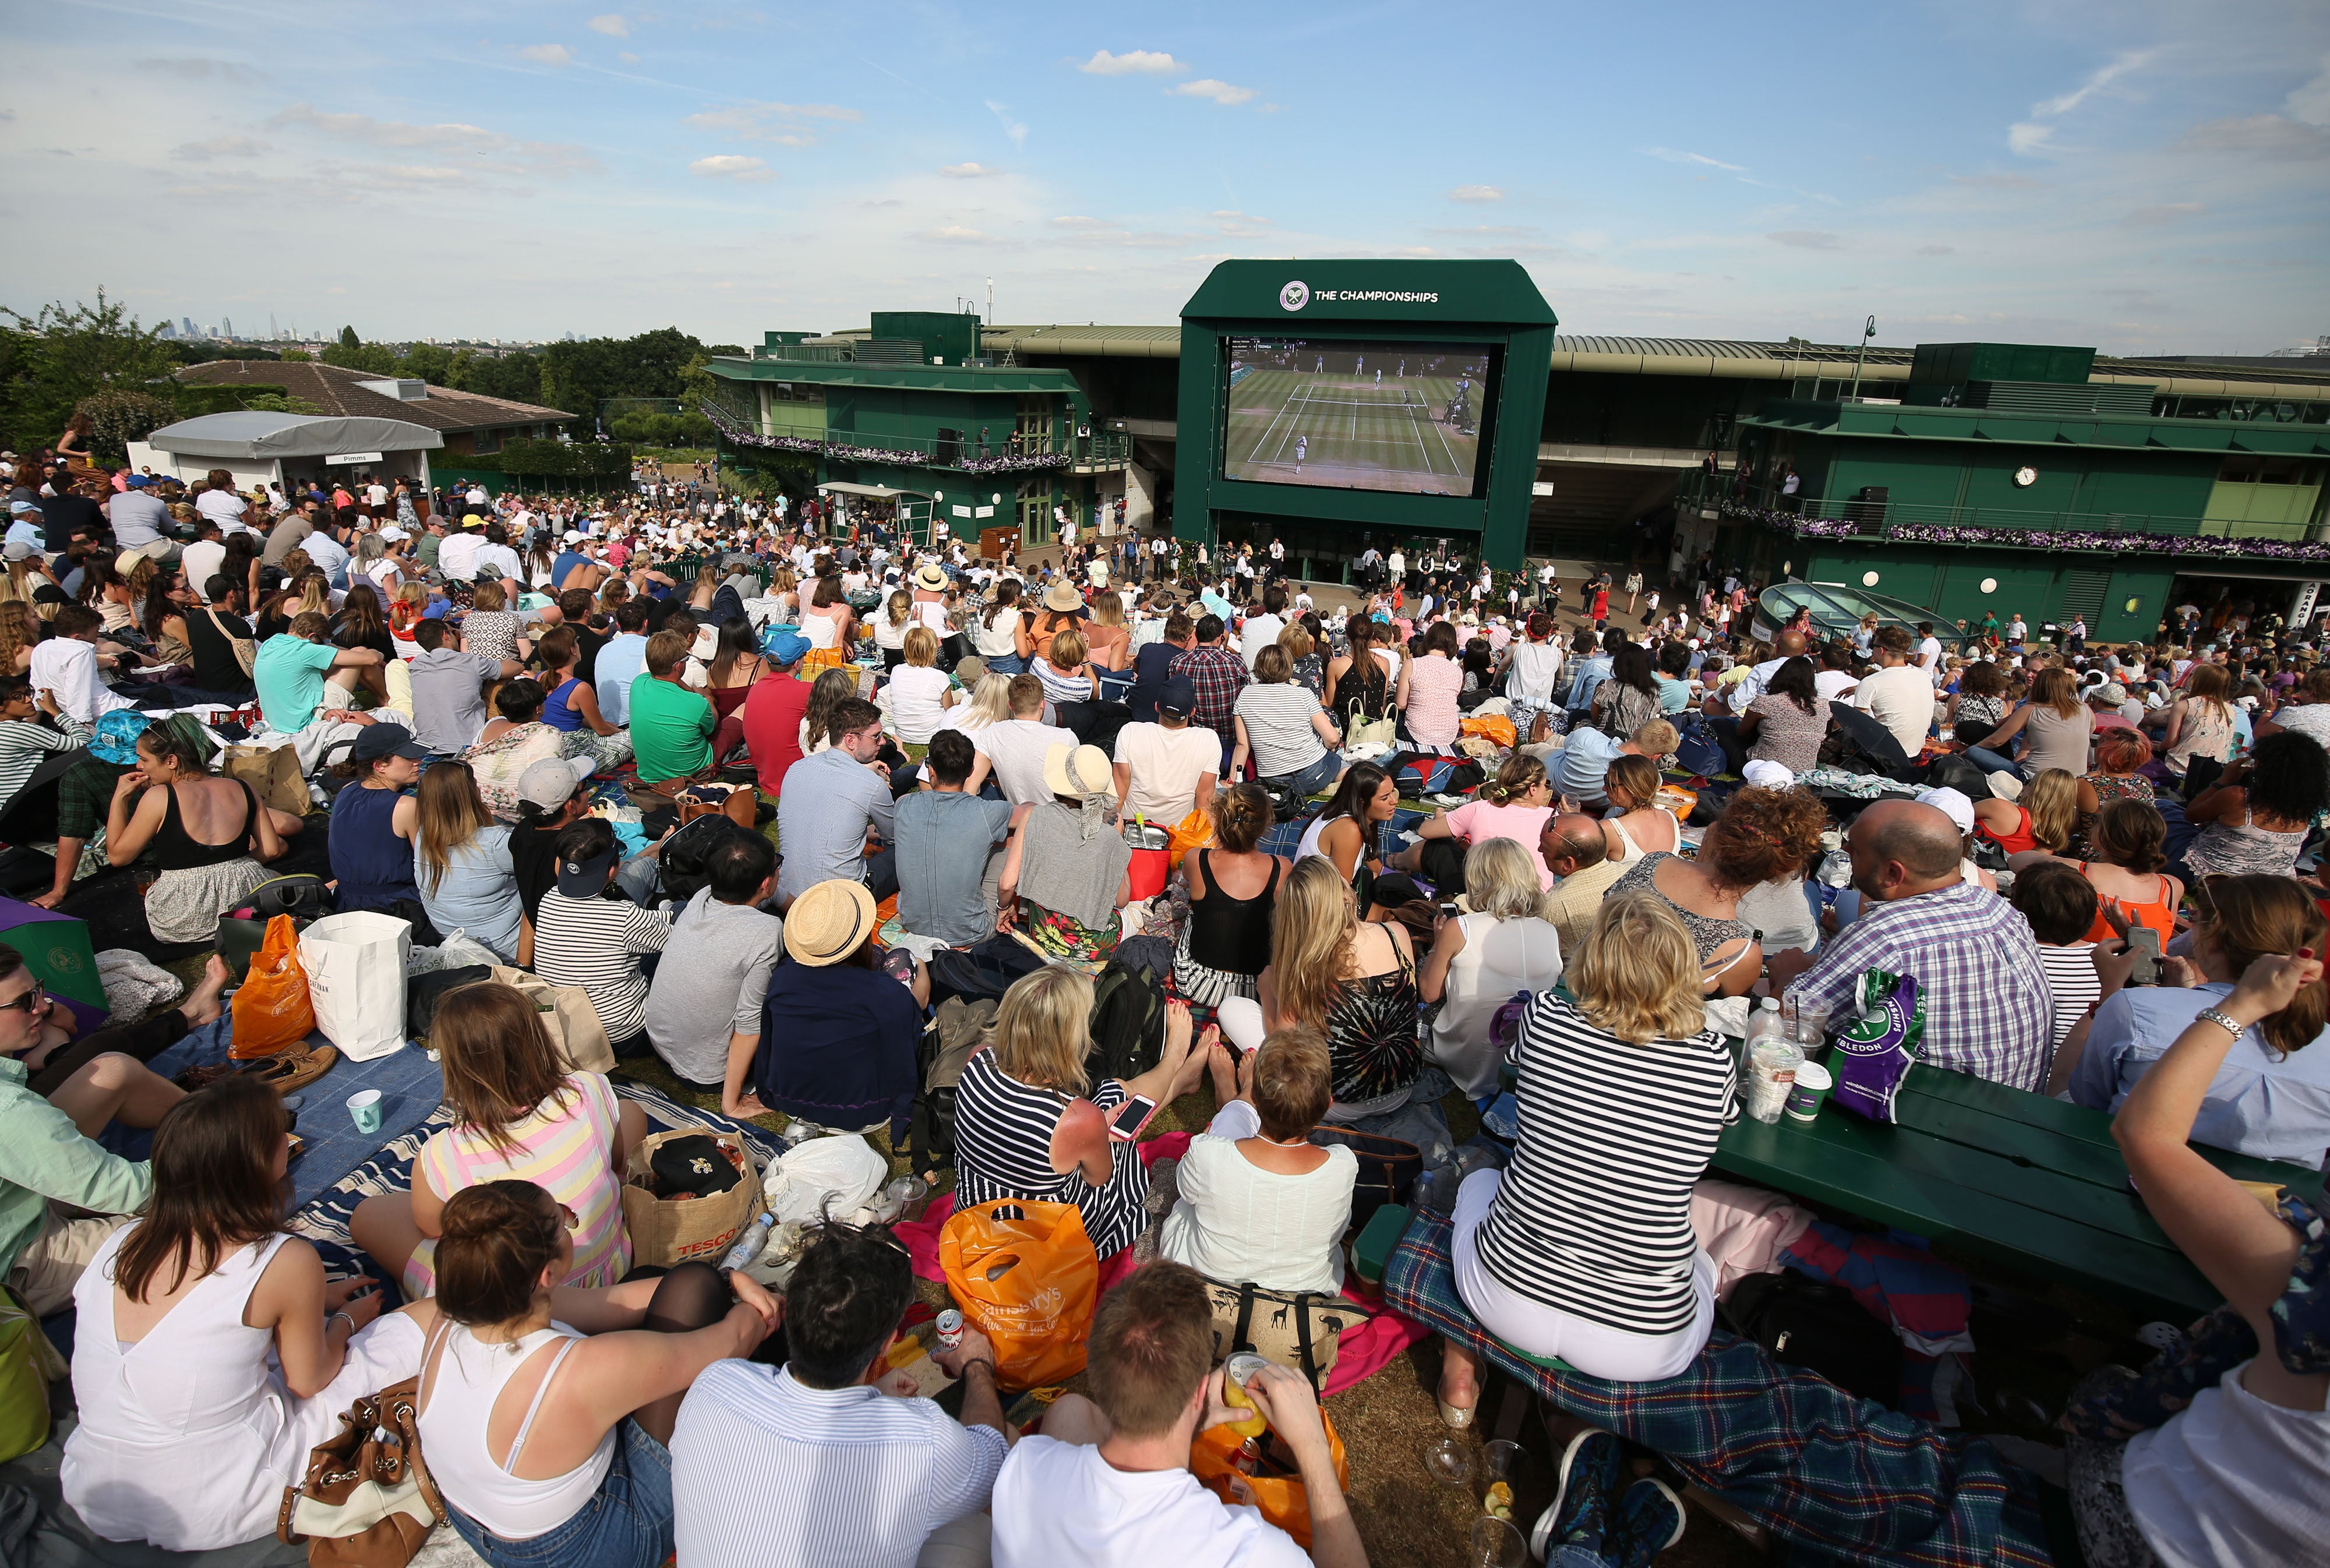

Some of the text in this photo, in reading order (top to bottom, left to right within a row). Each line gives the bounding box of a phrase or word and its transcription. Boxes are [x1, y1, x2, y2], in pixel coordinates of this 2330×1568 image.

[1315, 291, 1438, 303] THE CHAMPIONSHIPS
[2297, 583, 2315, 624] AORANGI
[408, 955, 444, 975] aitrose
[309, 979, 329, 993] SHERMAN
[678, 1228, 736, 1255] TESCO
[732, 1253, 743, 1262] evian
